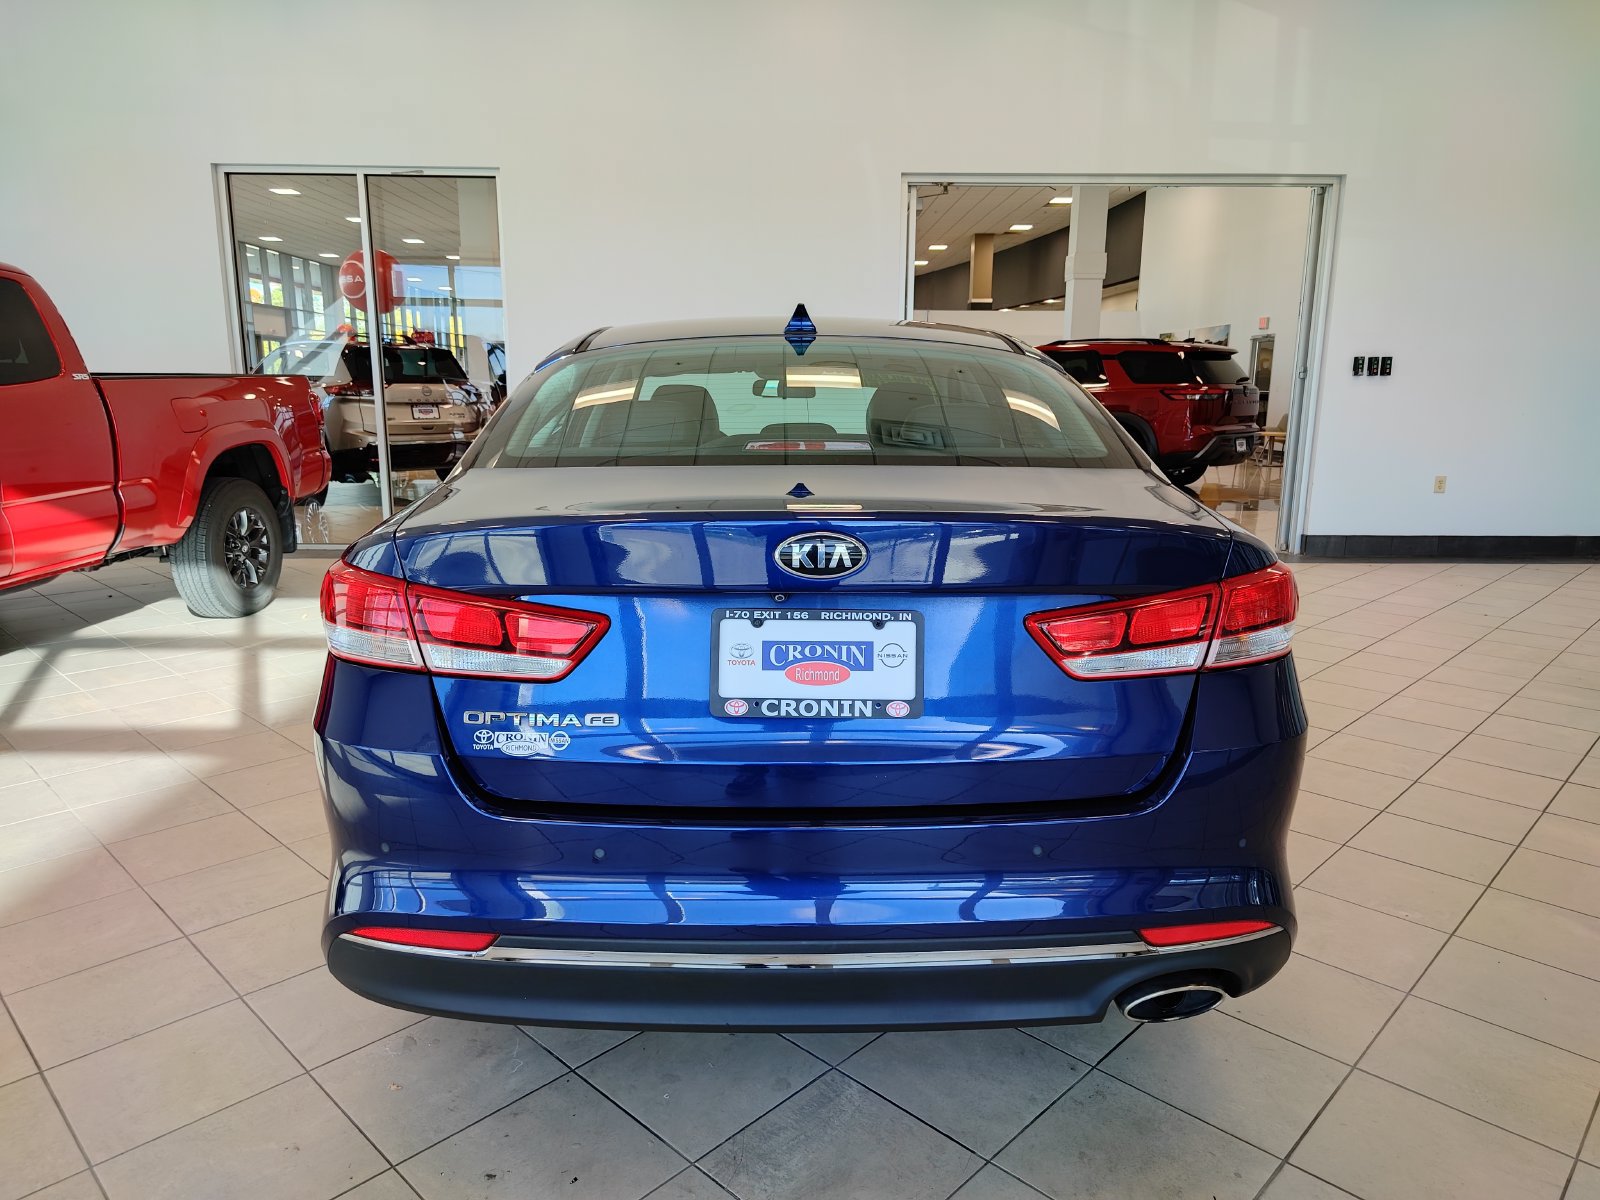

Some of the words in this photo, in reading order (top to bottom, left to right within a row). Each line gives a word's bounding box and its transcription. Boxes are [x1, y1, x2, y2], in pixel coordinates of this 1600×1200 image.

[790, 543, 853, 568] KIA
[725, 611, 750, 619] I-70
[754, 611, 781, 619] EXIT
[786, 611, 809, 620] 156
[821, 612, 895, 621] RICHMOND,
[899, 612, 912, 621] IN
[769, 644, 867, 667] CRONIN
[795, 667, 840, 681] Richmond
[761, 700, 873, 717] CRONIN
[463, 710, 583, 727] OPTIMA
[496, 733, 548, 744] CRONIN
[505, 744, 537, 752] RICHMOND
